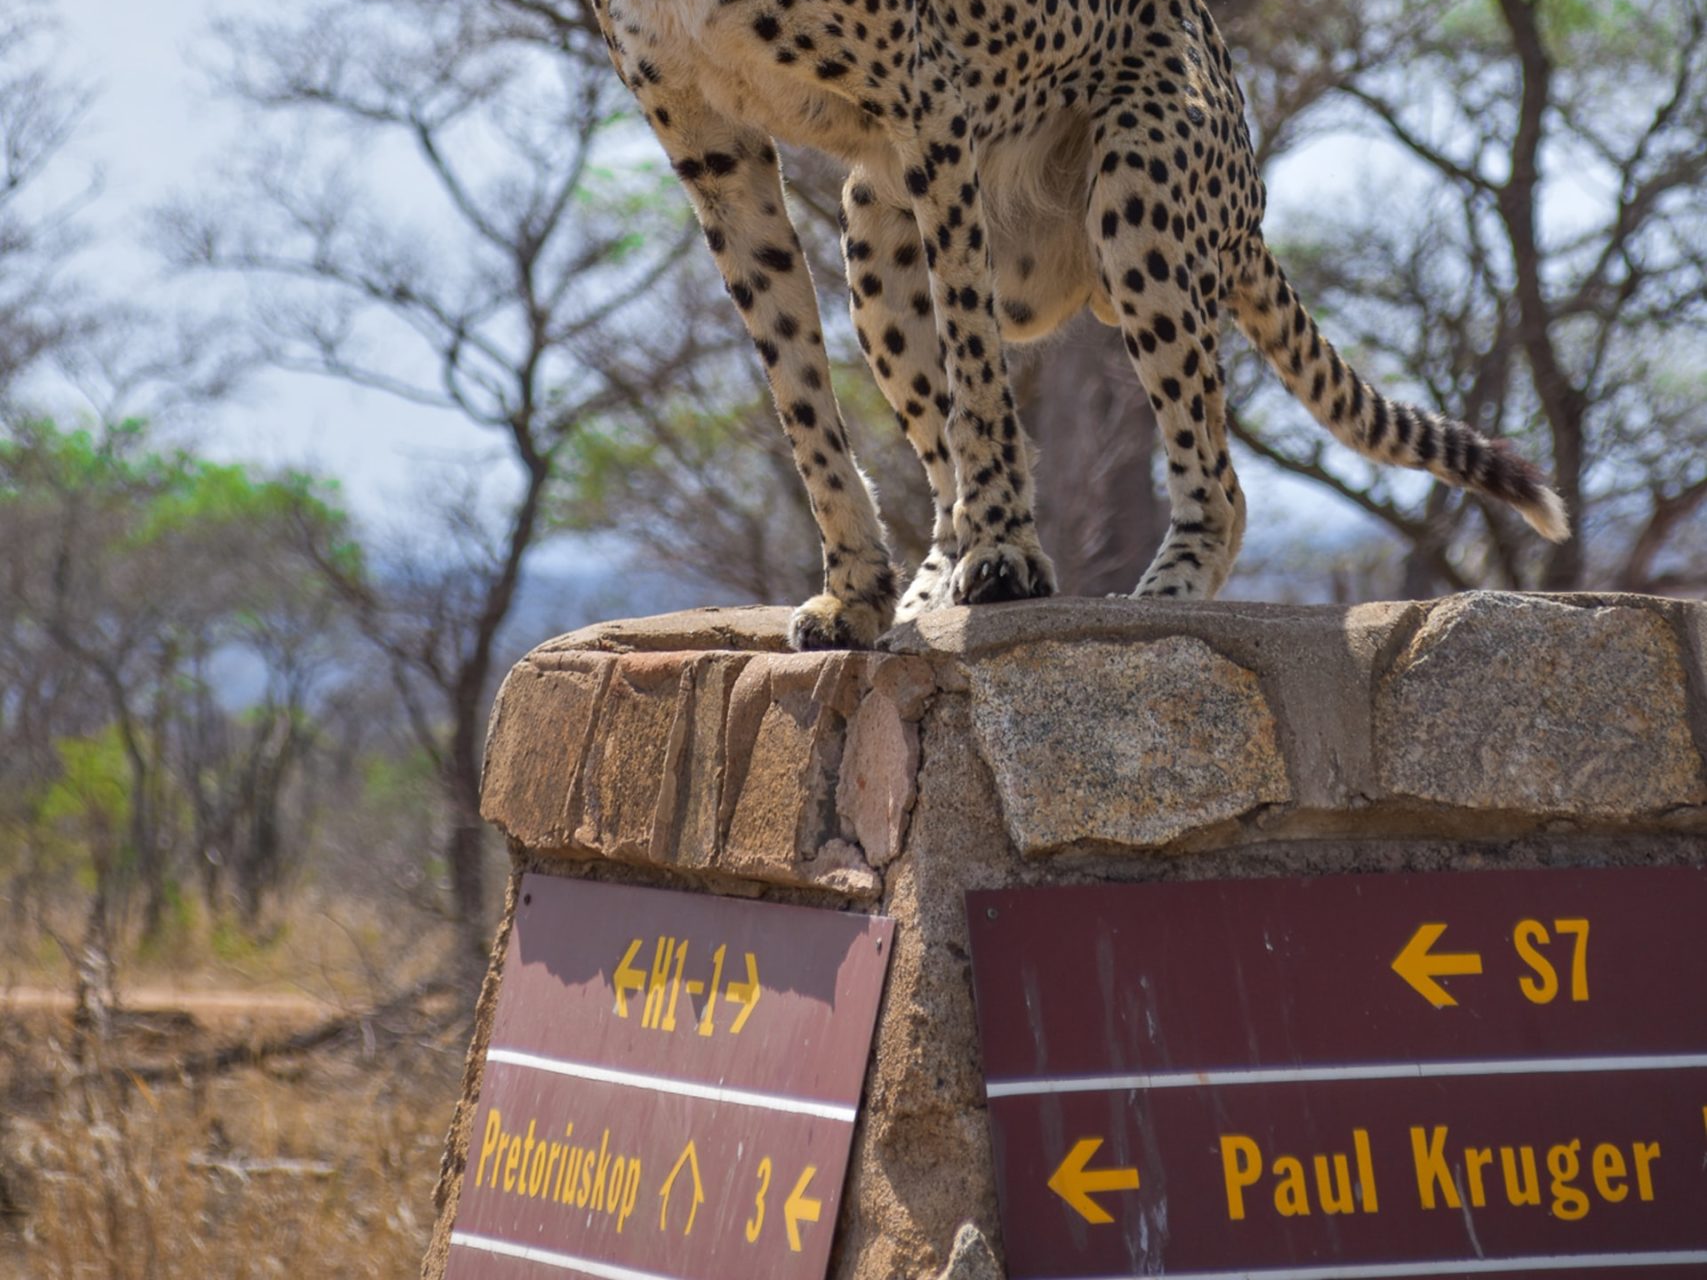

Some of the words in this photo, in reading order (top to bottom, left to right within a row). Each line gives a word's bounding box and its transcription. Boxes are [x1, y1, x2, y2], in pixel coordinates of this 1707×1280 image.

[641, 935, 727, 1037] H1-1
[1513, 918, 1591, 1005] S7
[475, 1107, 641, 1233] Pretoriuskop
[745, 1157, 772, 1243] 3
[1220, 1128, 1378, 1221] Paul
[1410, 1125, 1661, 1221] Kruger
